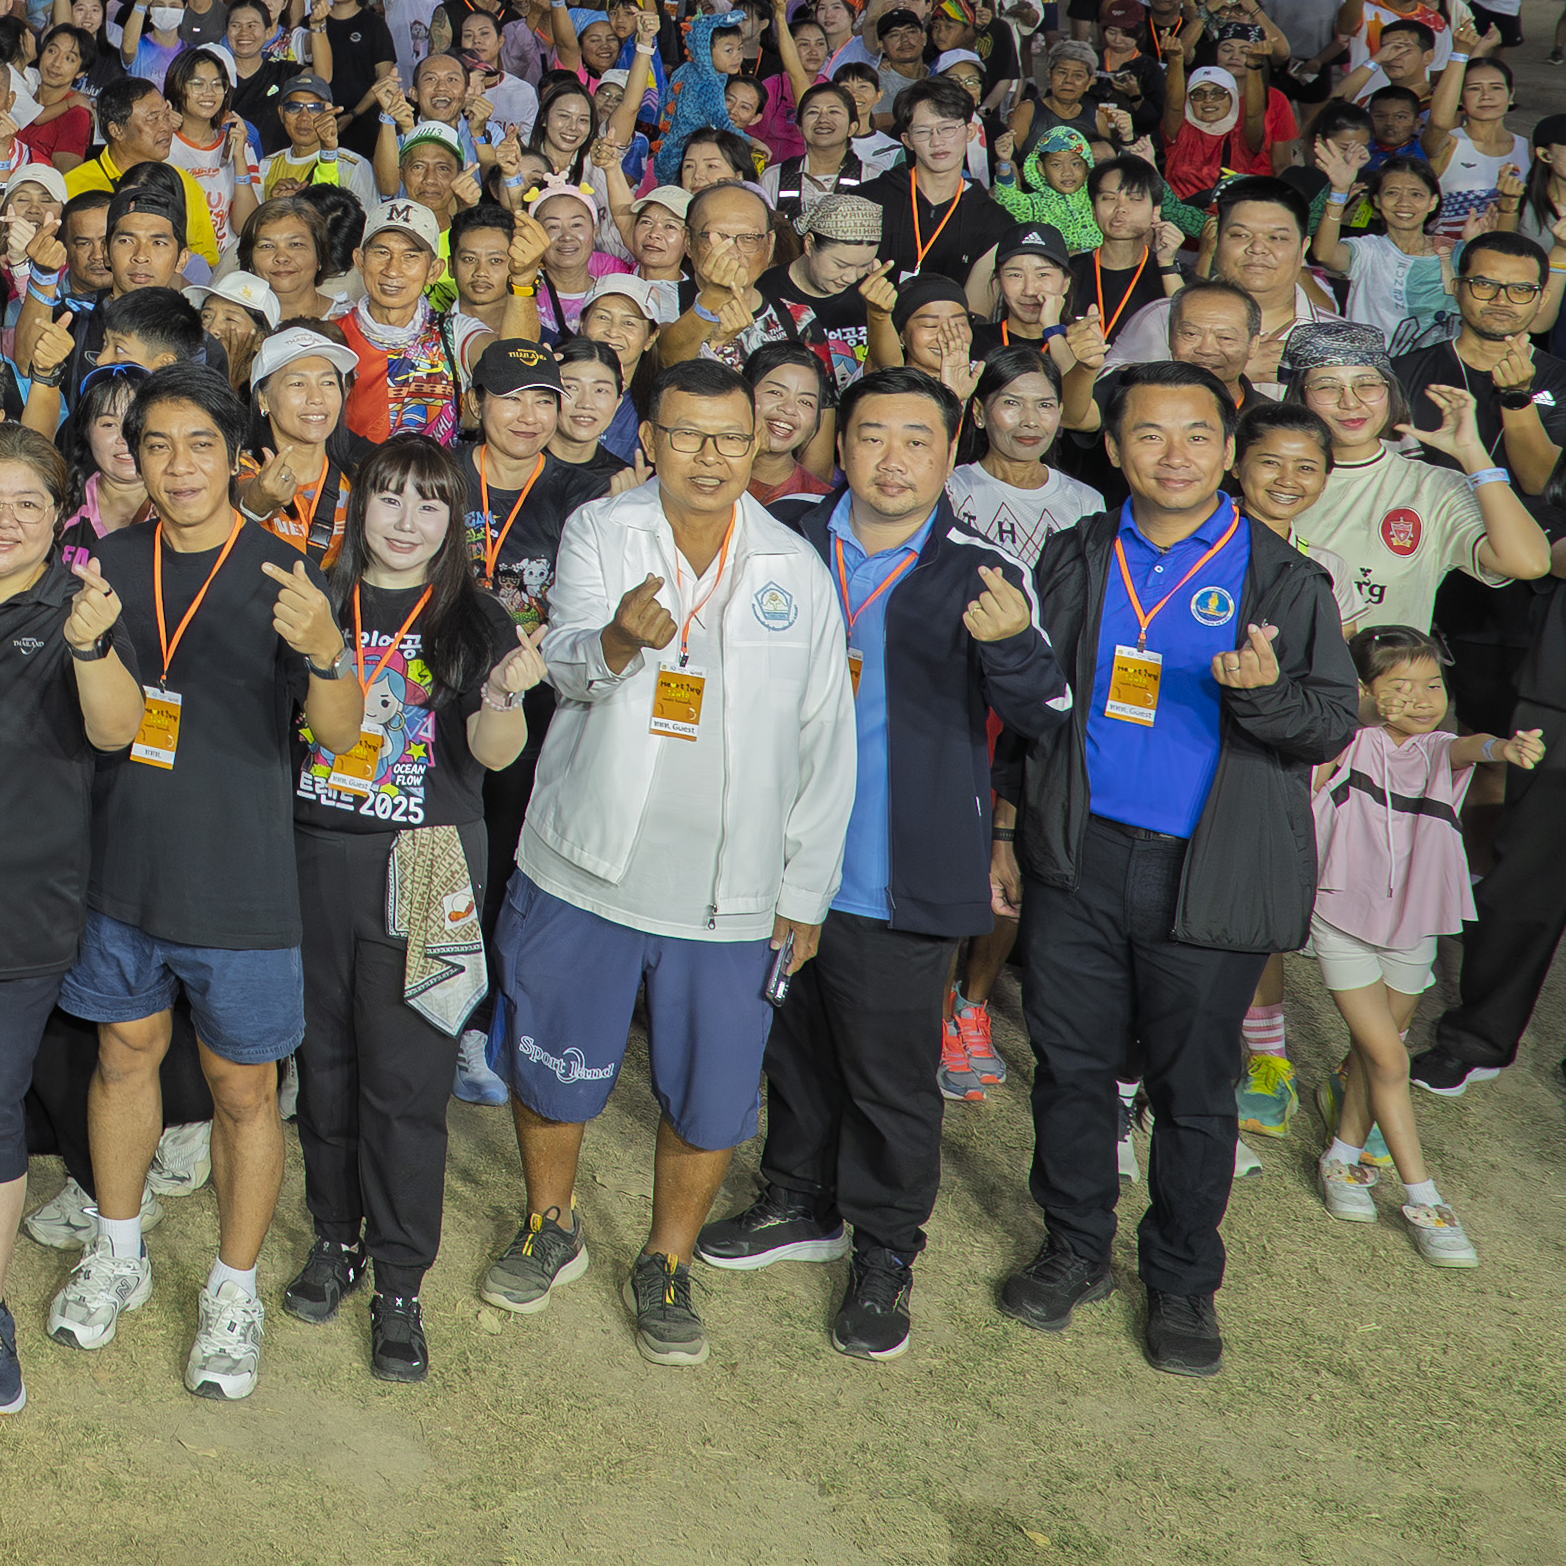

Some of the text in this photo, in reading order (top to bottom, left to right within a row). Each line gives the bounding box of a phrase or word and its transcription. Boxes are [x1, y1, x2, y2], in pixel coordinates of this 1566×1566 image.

[386, 204, 414, 223] M
[823, 325, 868, 347] 어공주
[1128, 708, 1152, 718] Guest
[672, 724, 695, 734] Guest
[393, 763, 427, 776] OCEAN
[348, 779, 368, 790] Guest
[395, 775, 423, 787] FLOW
[358, 791, 426, 825] 2025
[518, 1035, 566, 1075] Sport
